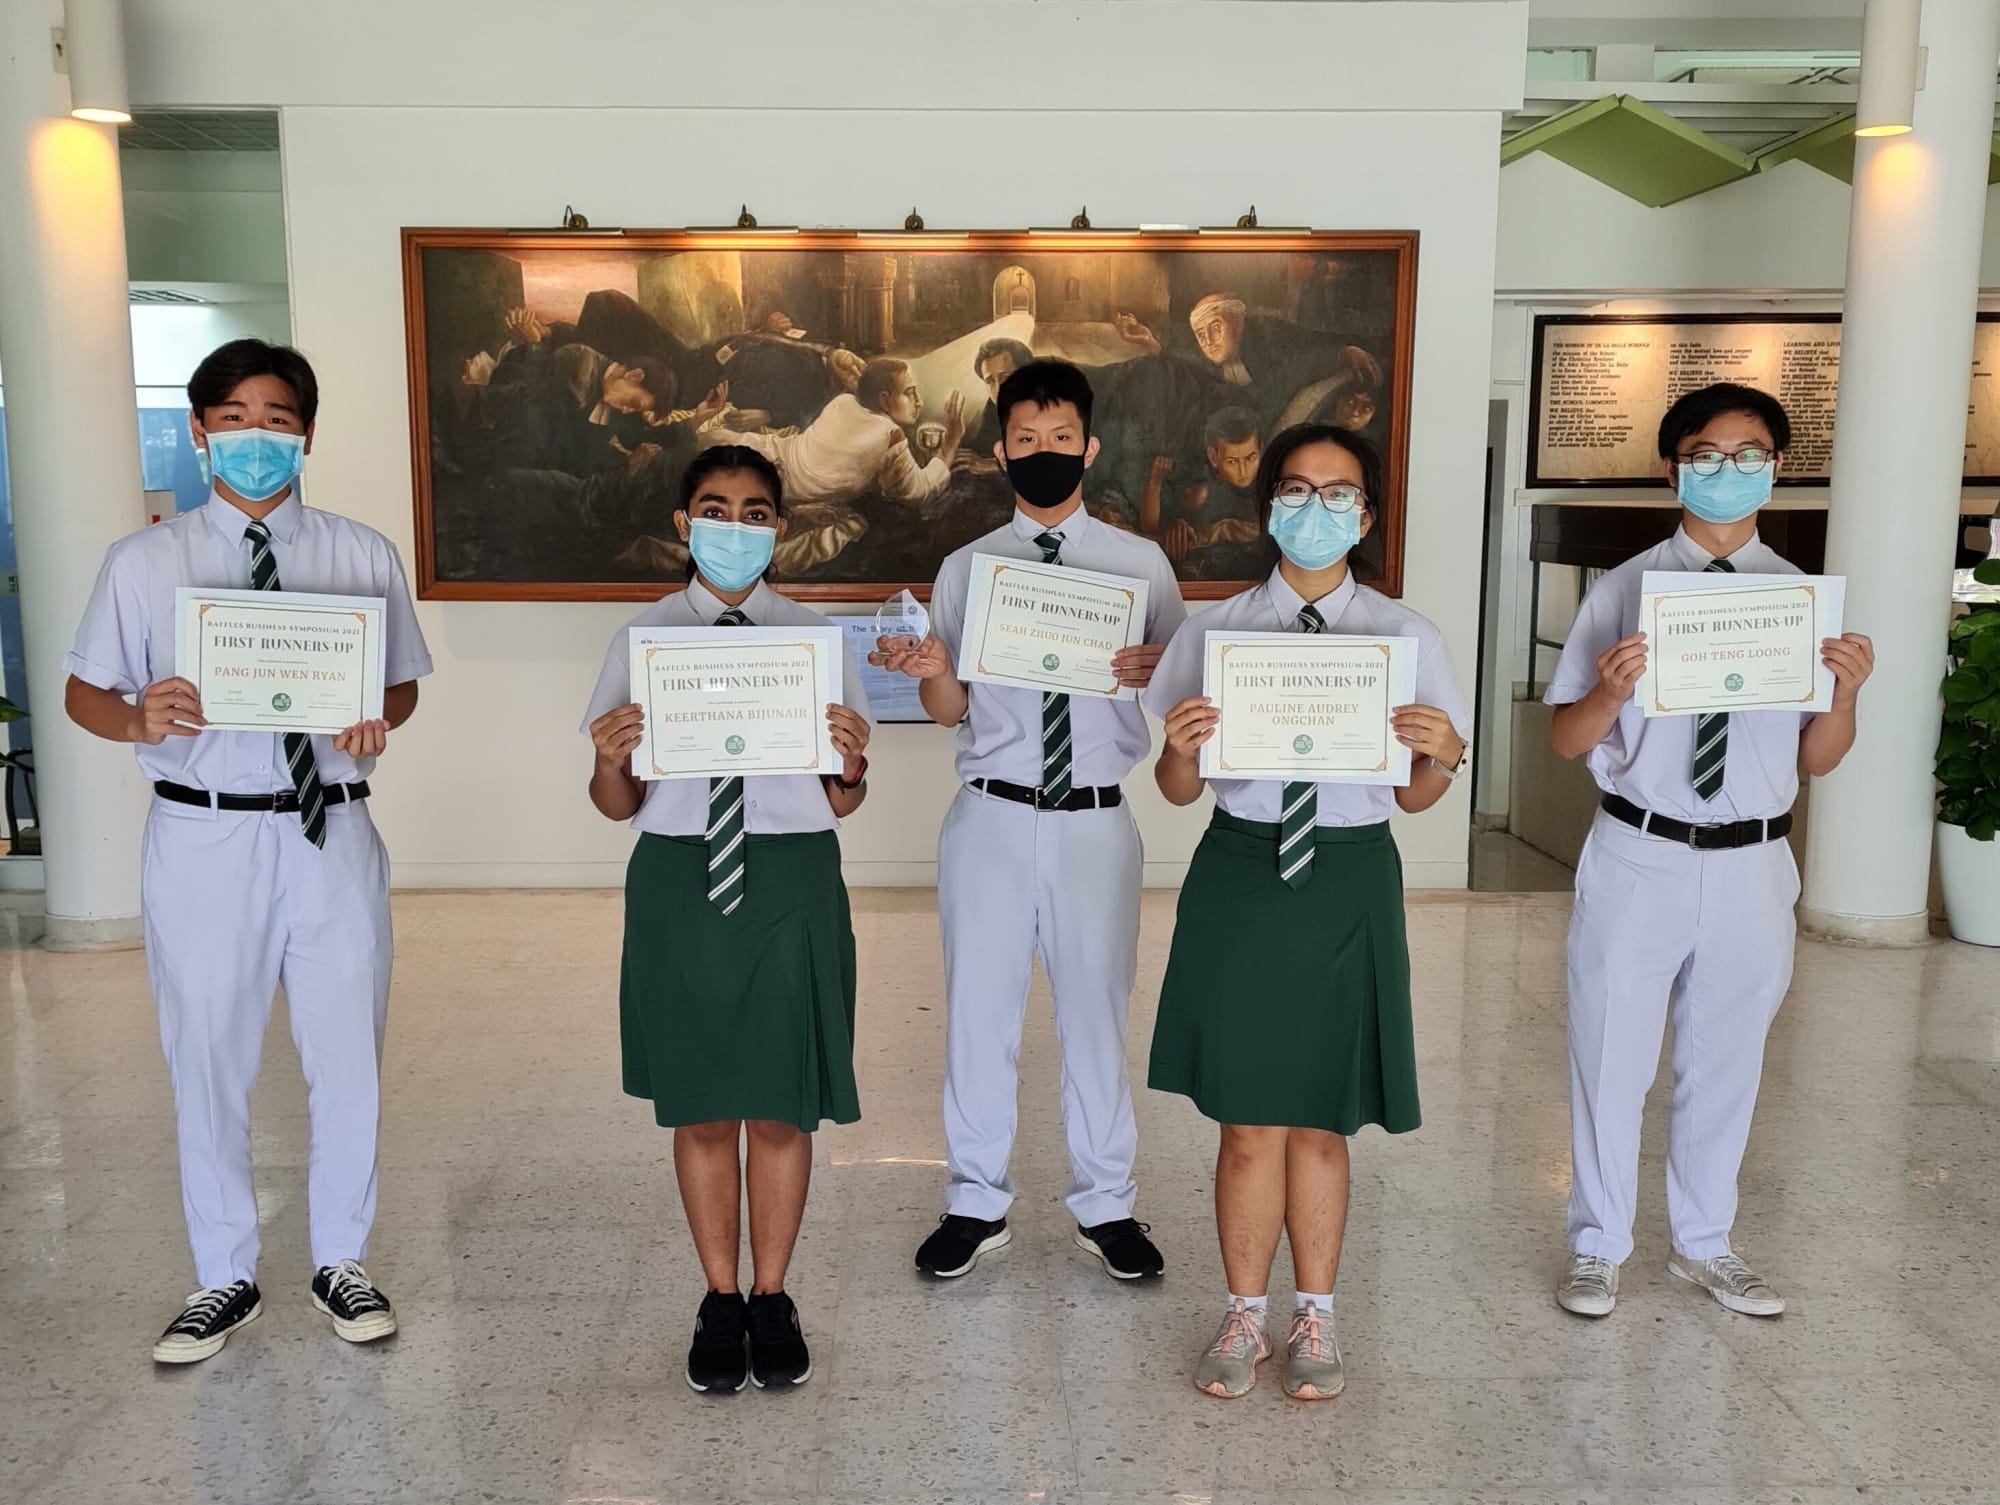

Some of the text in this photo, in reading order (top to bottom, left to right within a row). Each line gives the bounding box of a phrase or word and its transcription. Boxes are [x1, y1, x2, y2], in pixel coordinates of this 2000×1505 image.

[1000, 581, 1127, 609] RAFFLES BUSINESS SYMPOSIUM 2021
[1002, 595, 1037, 610] FIRST
[1041, 602, 1120, 626] RUNNERS-UP
[1662, 609, 1696, 618] RAFFLES
[1698, 608, 1737, 616] BUSINESS
[1740, 604, 1788, 613] SYMPOSIUM
[246, 623, 287, 631] BUSINESS
[289, 625, 339, 634] SYMPOSIUM
[870, 625, 892, 634] Sory
[1669, 616, 1803, 635] FIRST RUNNERS-UP
[1000, 623, 1026, 635] SEAH
[1030, 628, 1059, 641] ZHUO
[1061, 633, 1081, 644] JUN
[1083, 638, 1112, 649] CHAD
[214, 636, 353, 653] FIRST RUNNERS-UP
[1682, 648, 1791, 662] GOH TENG LOONG
[215, 667, 346, 681] PANG JUN WEN RYAN
[655, 664, 690, 672] RAFFLES
[663, 675, 803, 691] FIRST RUNNERS-UP
[1235, 676, 1376, 688] FIRST RUNNERS-UP
[665, 708, 807, 723] KEERTHANA BIJUNAIR
[1250, 704, 1359, 713] PAULINE AUDREY
[1272, 716, 1335, 726] ONGCHAN
